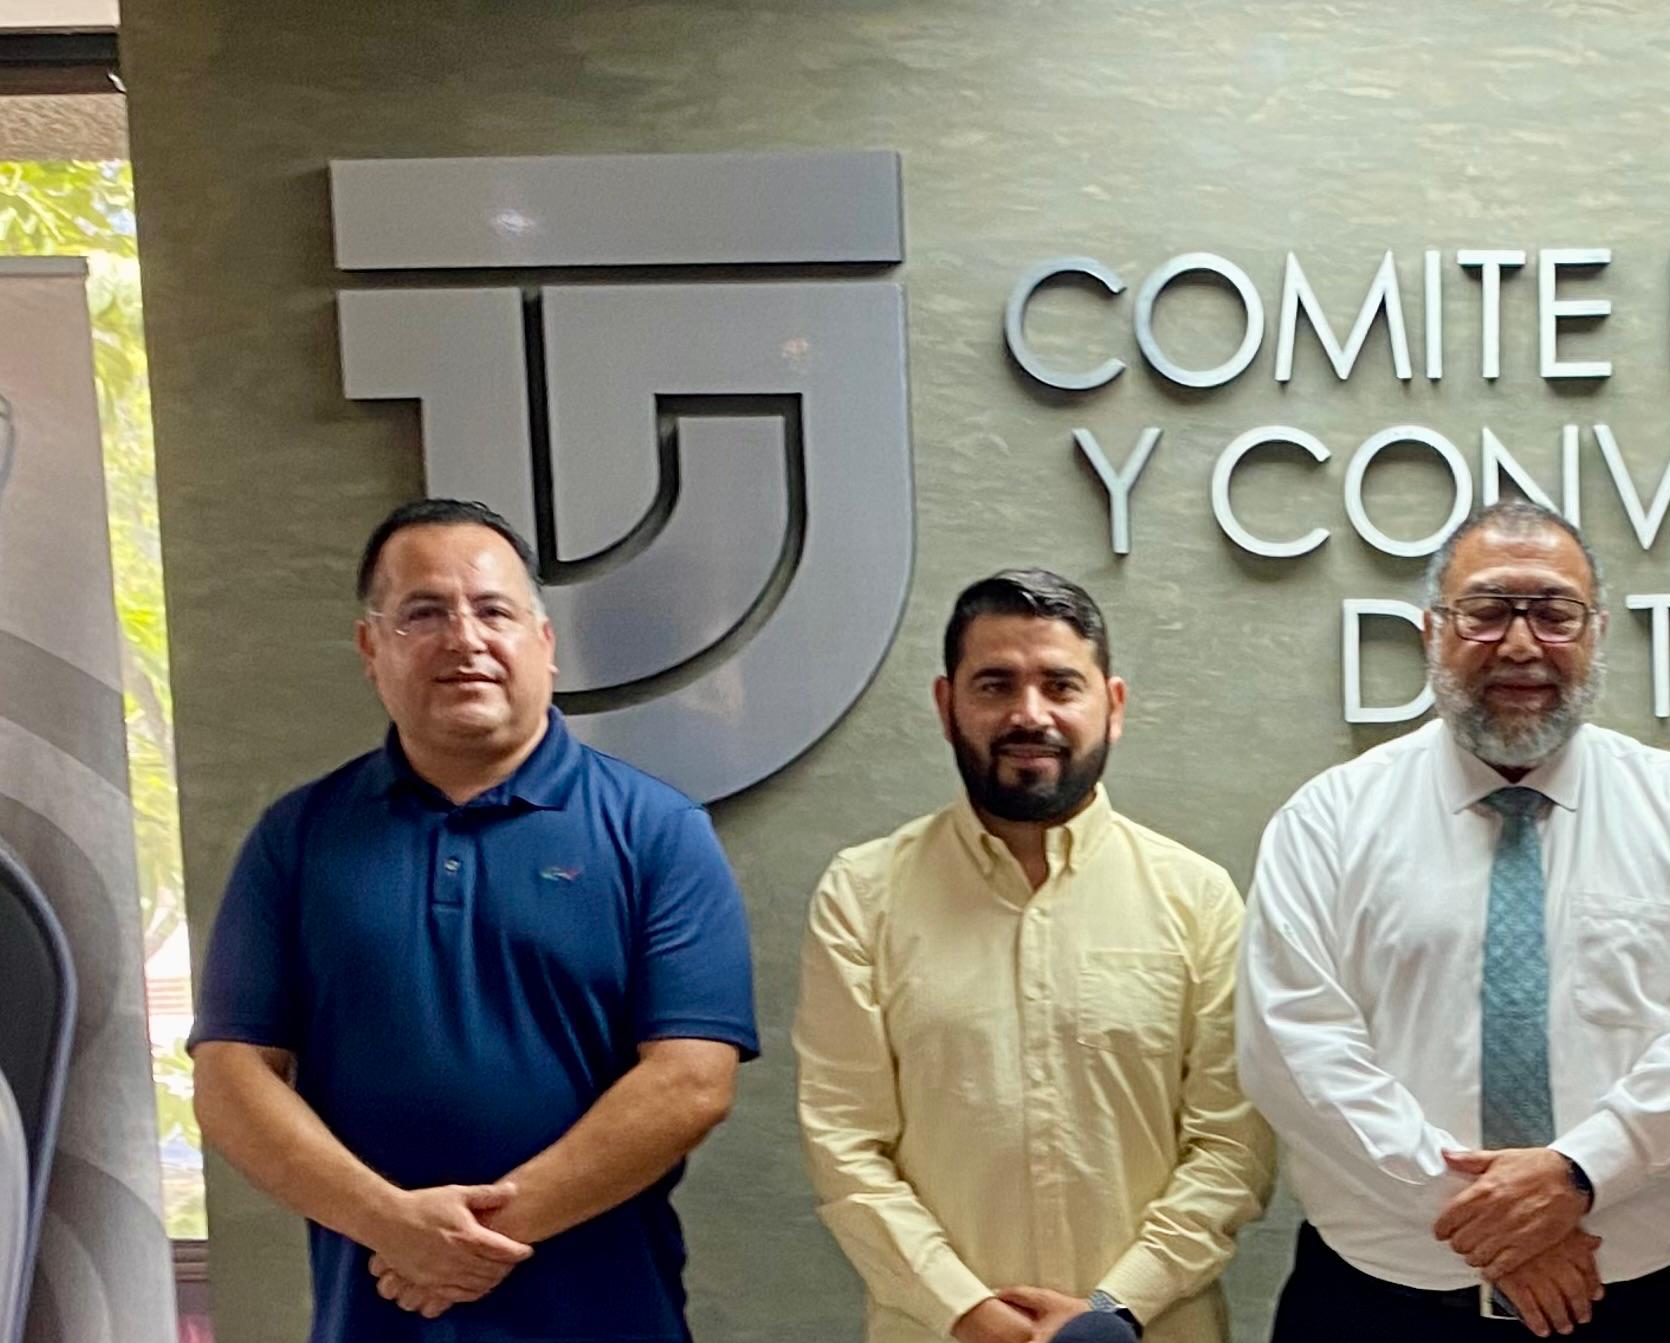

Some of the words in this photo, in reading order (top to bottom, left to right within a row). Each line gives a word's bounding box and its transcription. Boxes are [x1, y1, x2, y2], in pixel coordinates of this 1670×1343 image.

[1004, 248, 1613, 390] COMITE
[1073, 427, 1162, 555] Y
[1343, 598, 1436, 724] D
